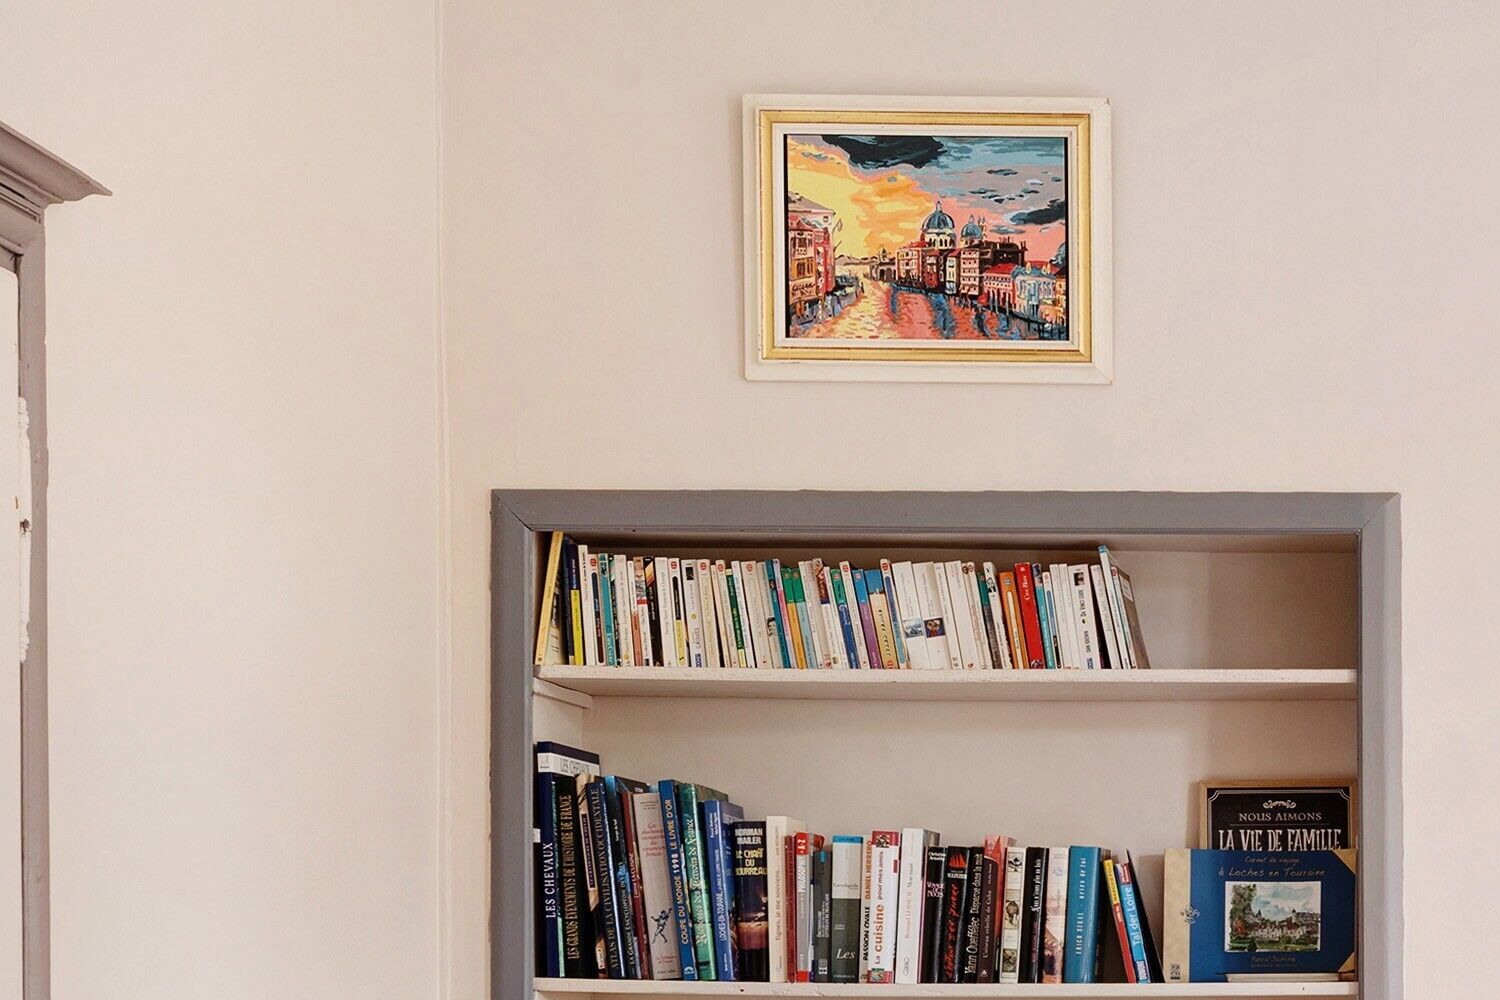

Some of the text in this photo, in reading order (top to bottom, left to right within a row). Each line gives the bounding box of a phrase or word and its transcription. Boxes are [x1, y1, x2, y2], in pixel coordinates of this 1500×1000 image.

[559, 795, 572, 819] FRANCE
[1239, 812, 1322, 821] NOUS AIMONS
[561, 821, 572, 830] DE
[667, 820, 675, 839] LIVRE
[682, 818, 697, 844] France
[561, 832, 575, 866] L'HISTOIRE
[670, 841, 678, 849] LE
[686, 846, 695, 855] de
[1219, 828, 1342, 852] LA VIE DE FAMILLE
[563, 868, 575, 876] DE
[745, 859, 755, 867] DU
[798, 855, 806, 892] PHILOSOPHIE
[1229, 867, 1264, 877] Loches
[1285, 869, 1327, 877] Touraine
[543, 842, 556, 918] LES CHEVAUX
[591, 789, 618, 968] ATLAS DE LA CIVILISATION OCCIDENTALE
[674, 875, 683, 904] MONDE
[864, 874, 872, 900] DANIEL
[972, 873, 982, 887] dans
[678, 906, 684, 917] DU
[970, 887, 982, 914] Disparue
[873, 904, 884, 952] cuisine
[1123, 887, 1141, 946] Tal der Loire
[567, 921, 579, 946] GRANDS
[679, 918, 689, 944] COUPE
[966, 917, 979, 953] Queffélec
[568, 947, 579, 959] LES
[836, 948, 855, 959] Les
[875, 956, 880, 964] La
[965, 955, 976, 973] Yann
